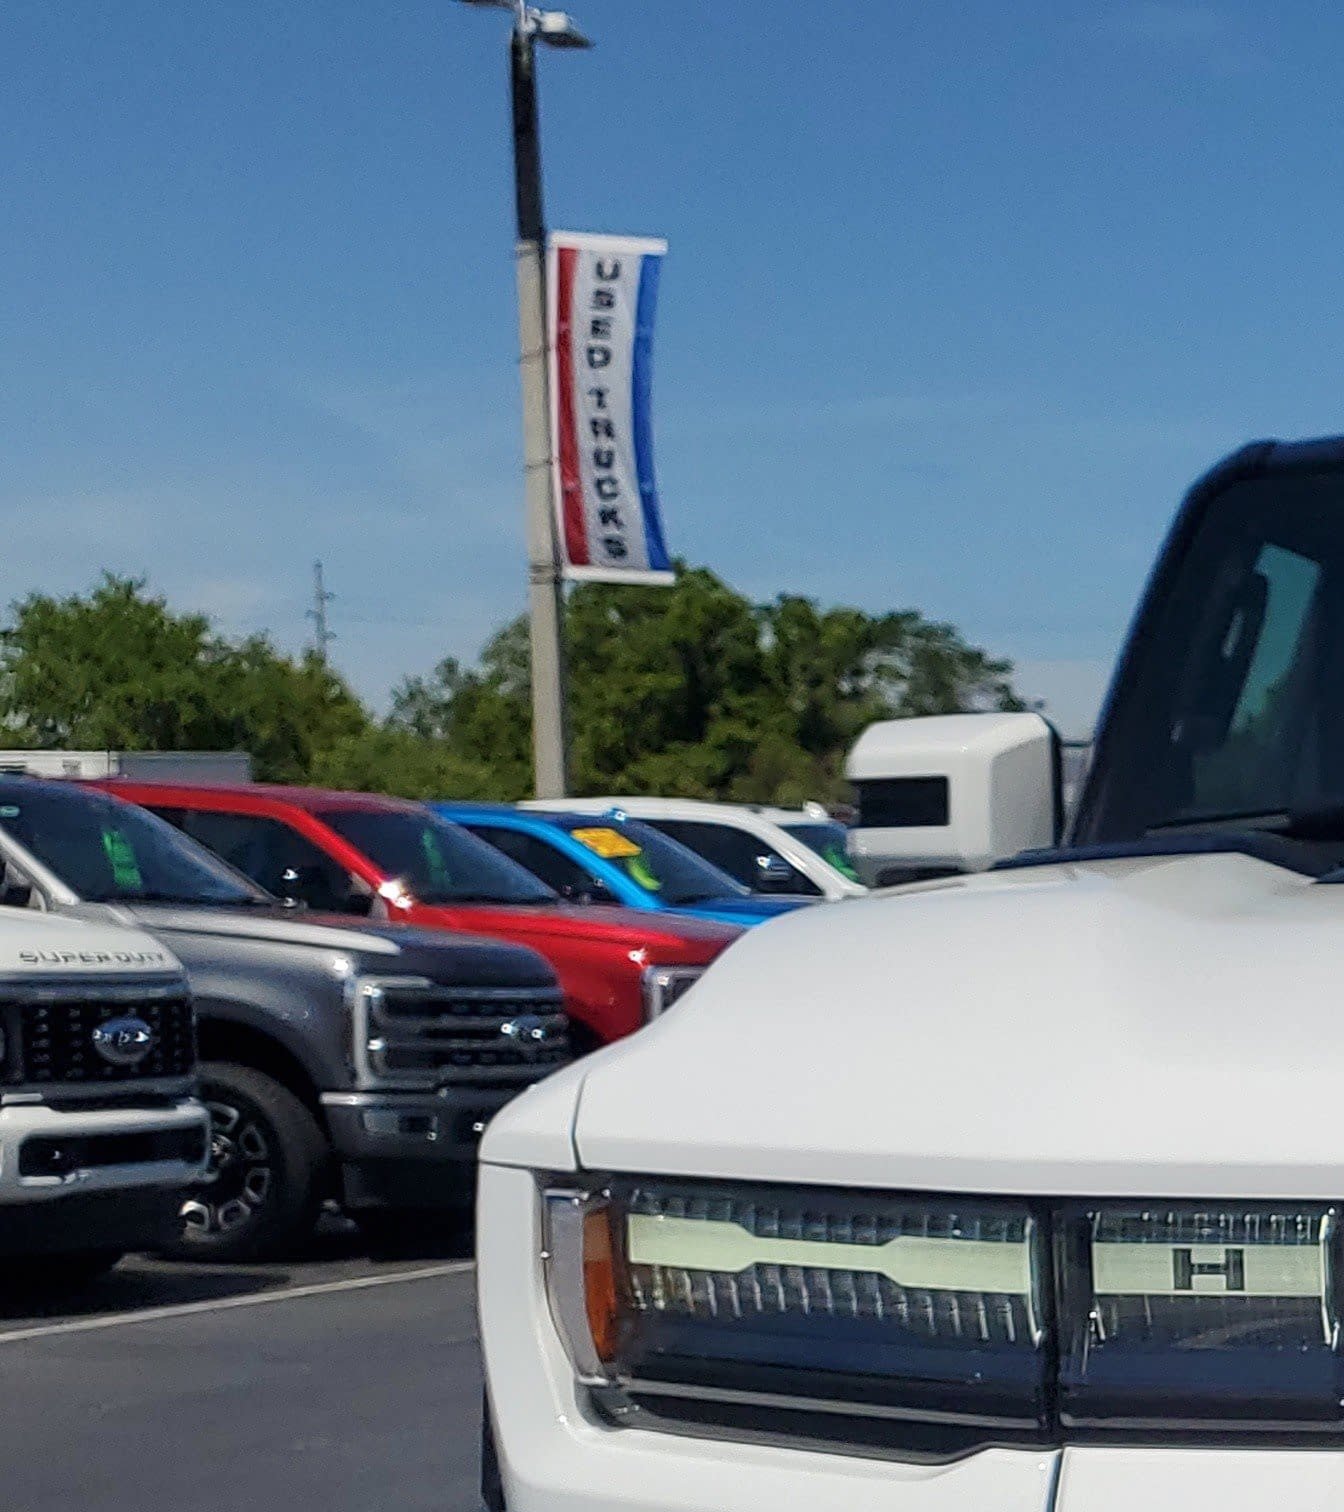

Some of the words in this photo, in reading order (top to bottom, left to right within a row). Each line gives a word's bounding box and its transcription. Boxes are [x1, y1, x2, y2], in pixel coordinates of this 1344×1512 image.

[586, 258, 622, 370] USED
[588, 386, 628, 559] TRUCKS
[19, 951, 111, 964] SUPER
